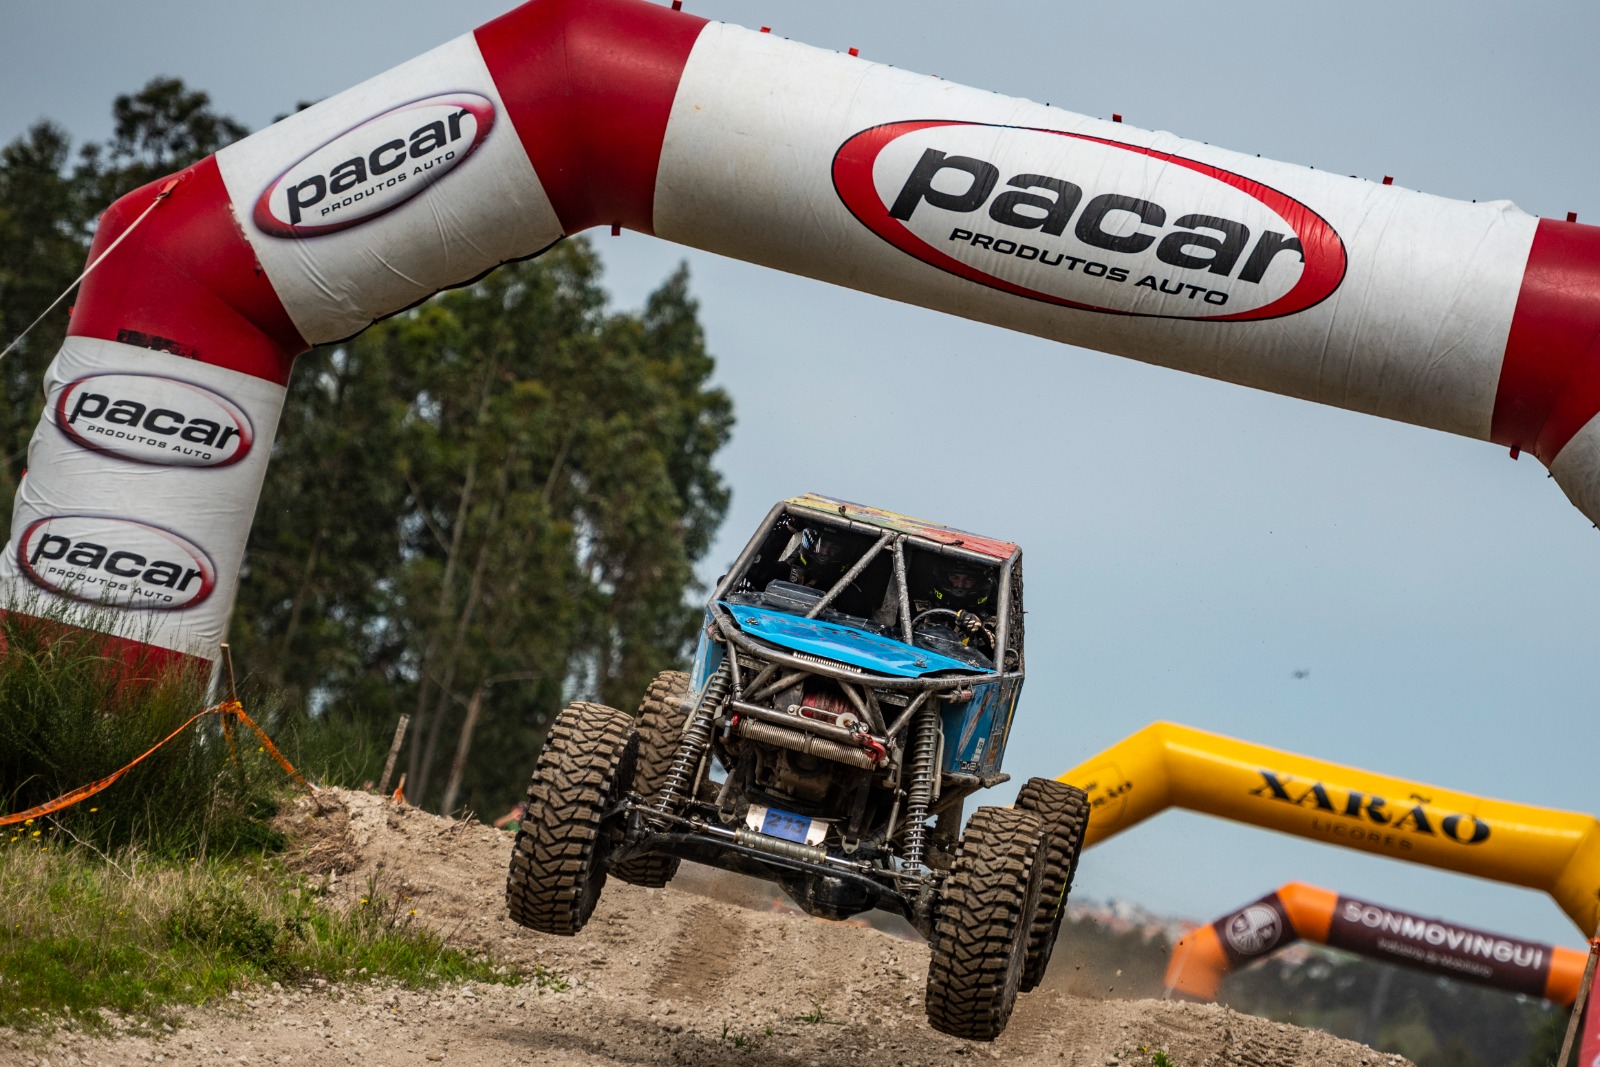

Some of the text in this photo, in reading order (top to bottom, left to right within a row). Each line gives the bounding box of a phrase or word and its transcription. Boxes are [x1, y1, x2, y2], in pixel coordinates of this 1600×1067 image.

[287, 108, 474, 226] pacar
[321, 150, 456, 217] PRODUTOS AUTO
[887, 147, 1305, 285] pacar
[948, 227, 1230, 306] PRODUTOS AUTO
[68, 391, 241, 450] pacar
[87, 425, 212, 461] PRODUTOS AUTO
[29, 533, 204, 592] pacar
[48, 567, 173, 603] PRODUTOS AUTO
[1248, 769, 1492, 846] XARÃO
[1311, 818, 1414, 850] LICORES
[1342, 901, 1544, 970] SONMOVINGUI
